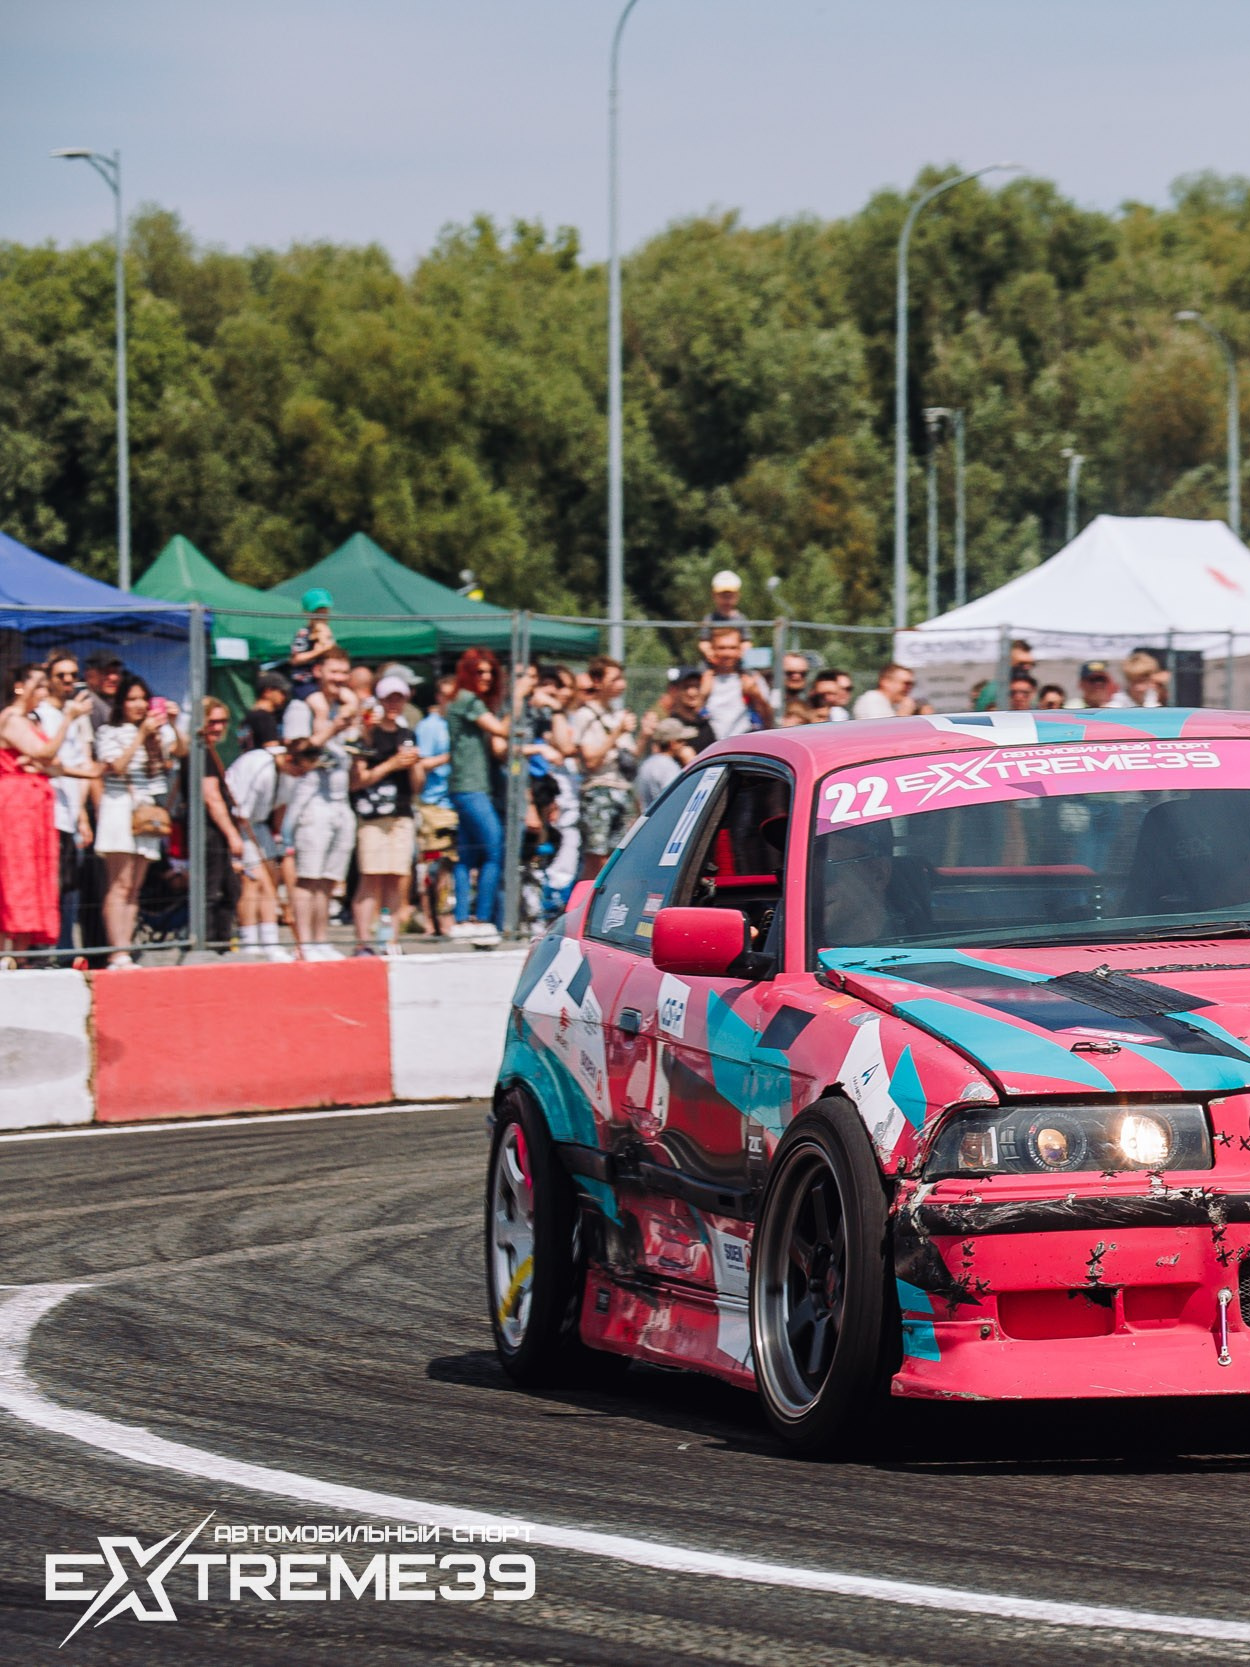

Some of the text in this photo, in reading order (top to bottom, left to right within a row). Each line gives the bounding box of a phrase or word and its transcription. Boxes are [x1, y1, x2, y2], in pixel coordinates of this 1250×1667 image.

[1002, 742, 1211, 759] АВТОМОБИЛЬНЫЙ СПОРТ
[825, 776, 893, 824] 22
[895, 749, 1222, 807] EXTREME39
